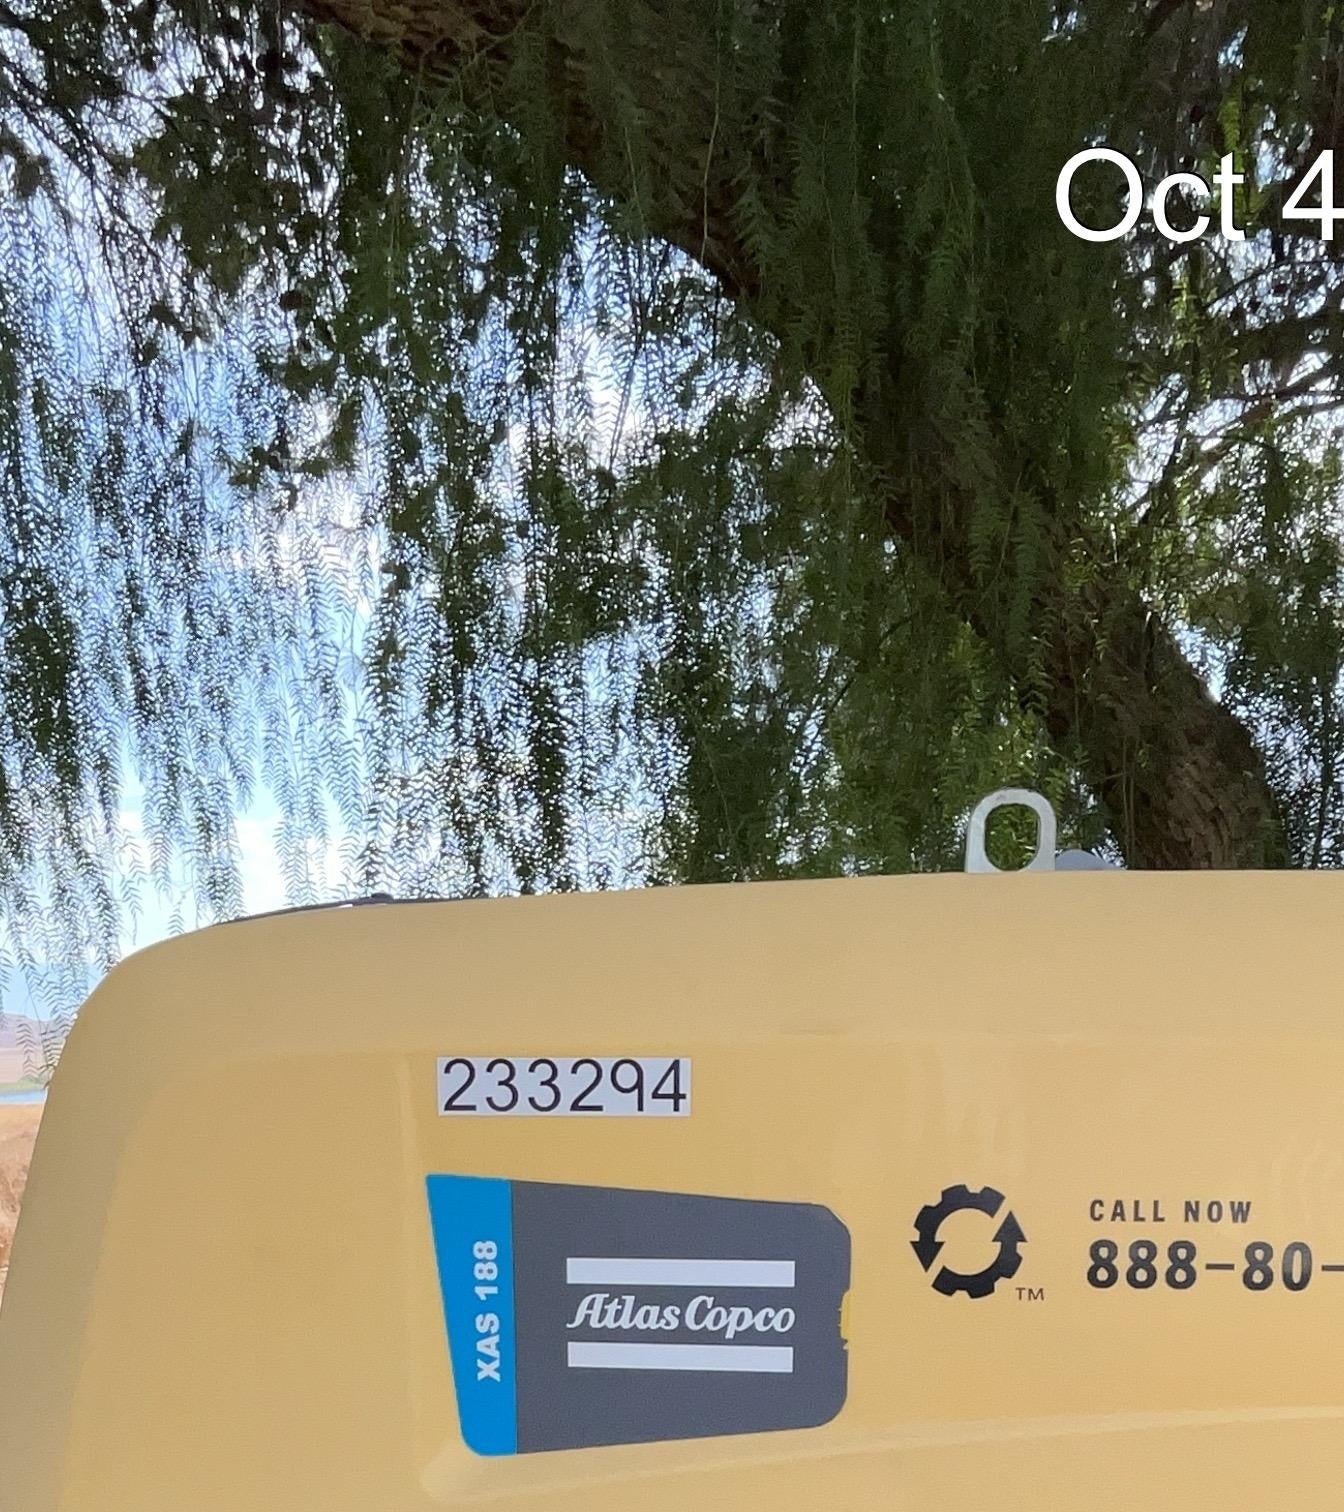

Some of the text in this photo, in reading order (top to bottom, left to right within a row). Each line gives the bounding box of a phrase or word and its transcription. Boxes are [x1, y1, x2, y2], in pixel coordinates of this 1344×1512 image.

[443, 1058, 687, 1112] 233294
[1089, 1199, 1253, 1223] CALL NOW
[472, 1239, 502, 1382] XAS 188
[566, 1293, 796, 1339] Atlas Copco
[1015, 1287, 1045, 1302] TM
